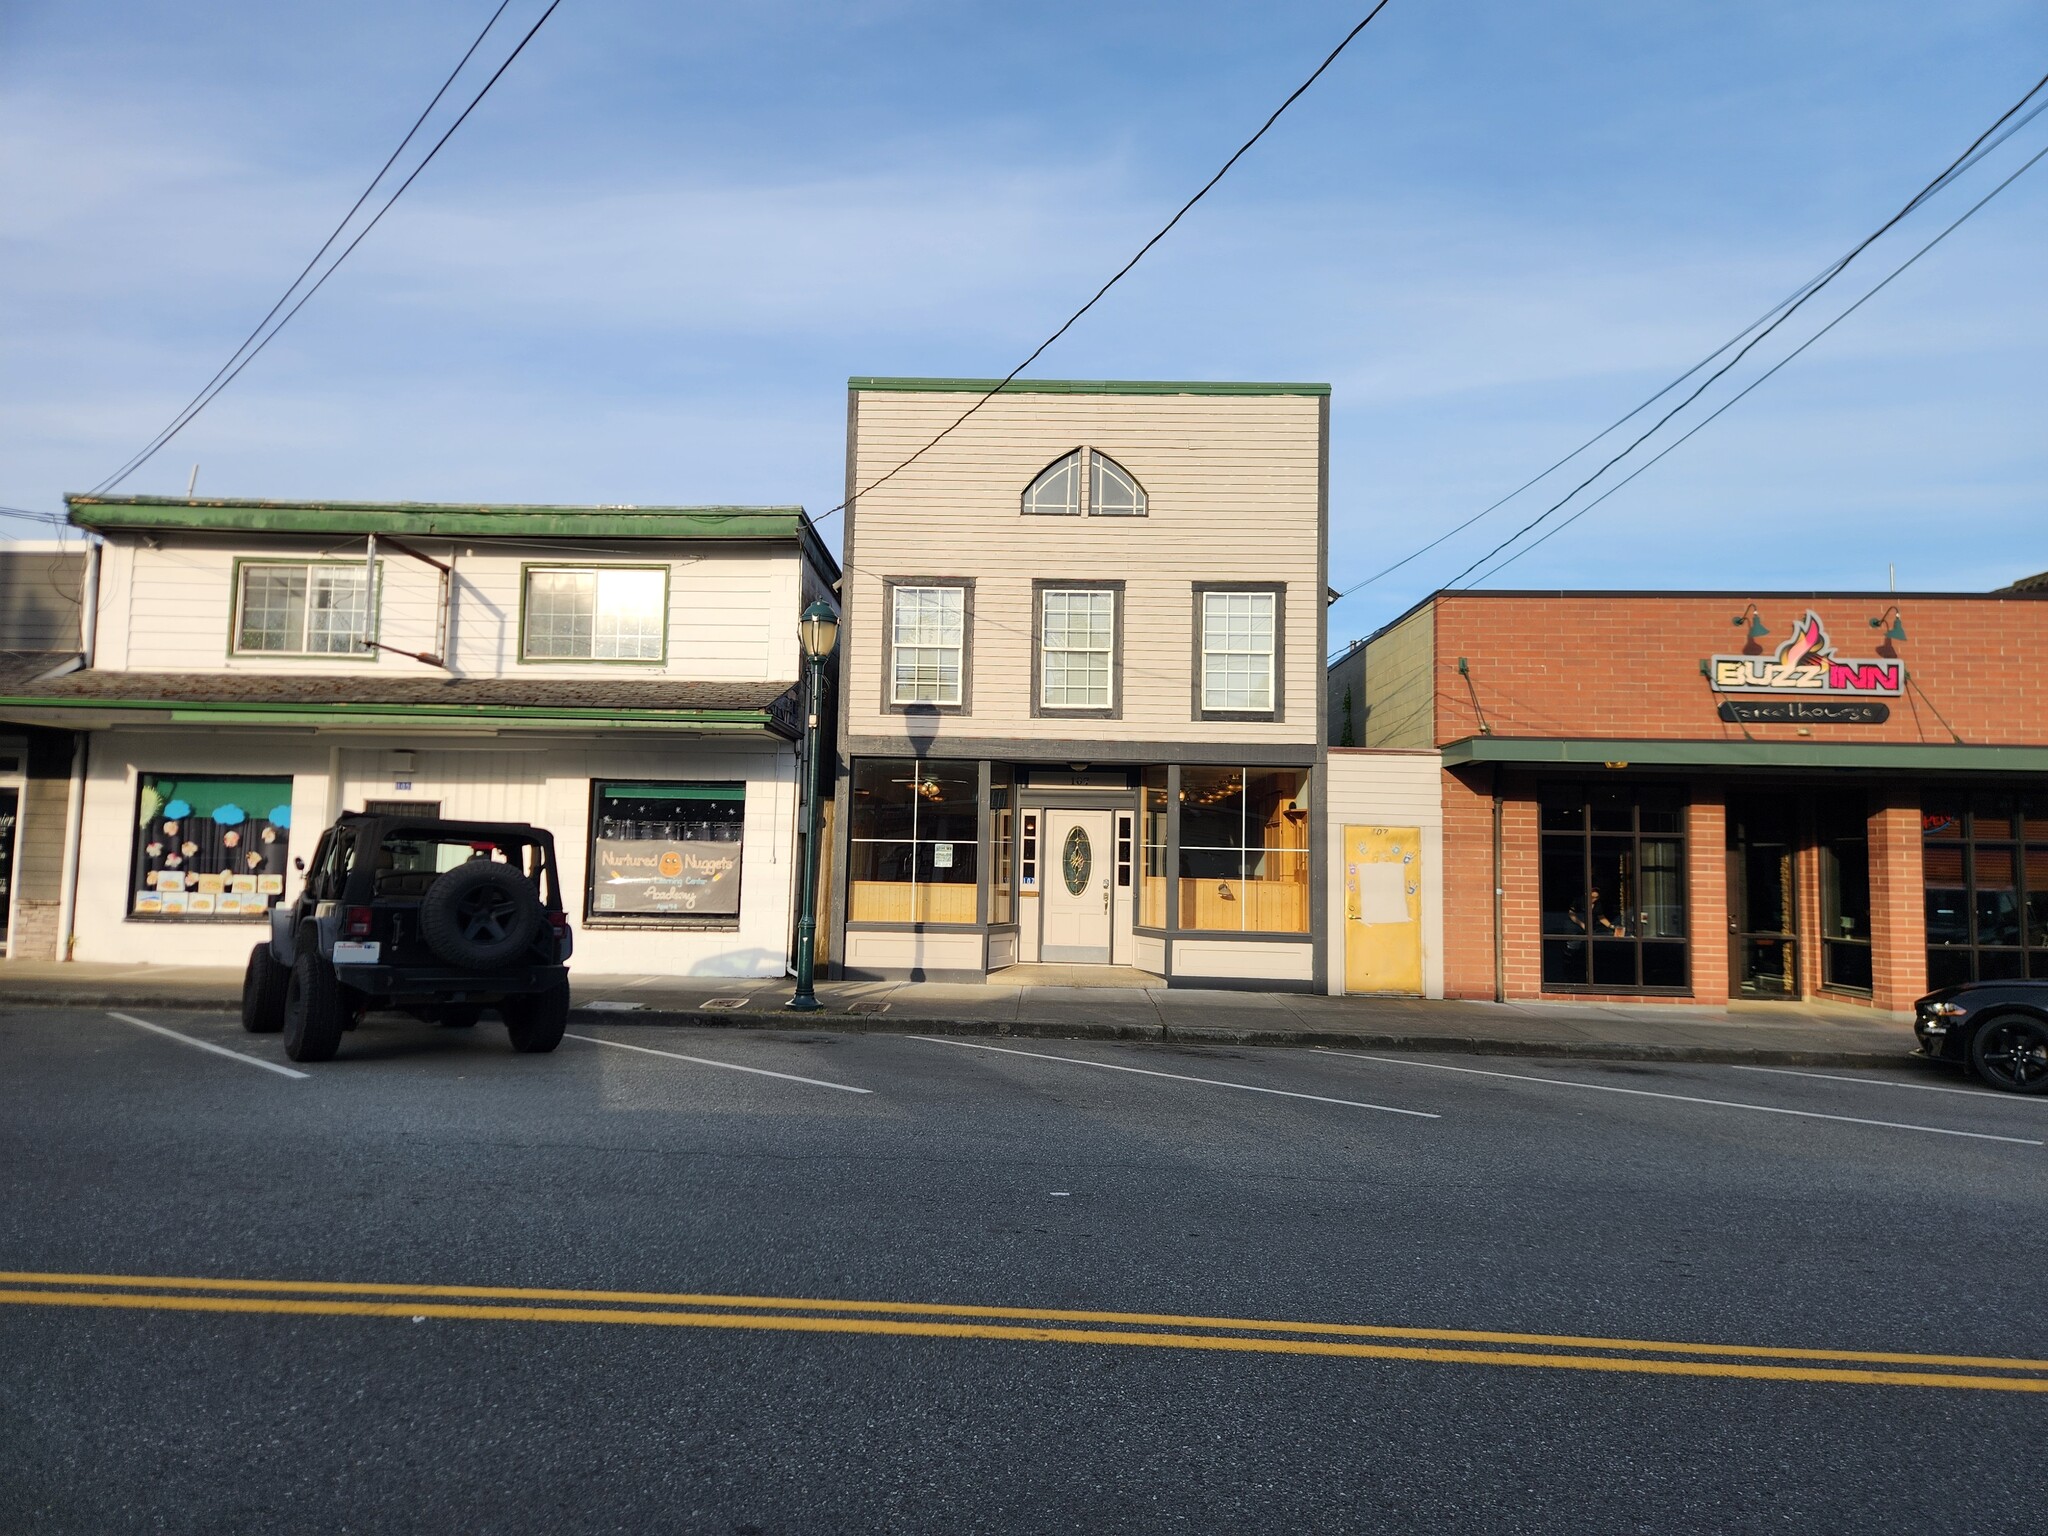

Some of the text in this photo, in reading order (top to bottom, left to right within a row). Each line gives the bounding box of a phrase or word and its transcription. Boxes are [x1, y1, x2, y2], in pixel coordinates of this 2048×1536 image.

[1716, 660, 1898, 690] BUZZ INN
[601, 850, 734, 876] Nurtured Nuggets
[643, 885, 697, 910] Academy
